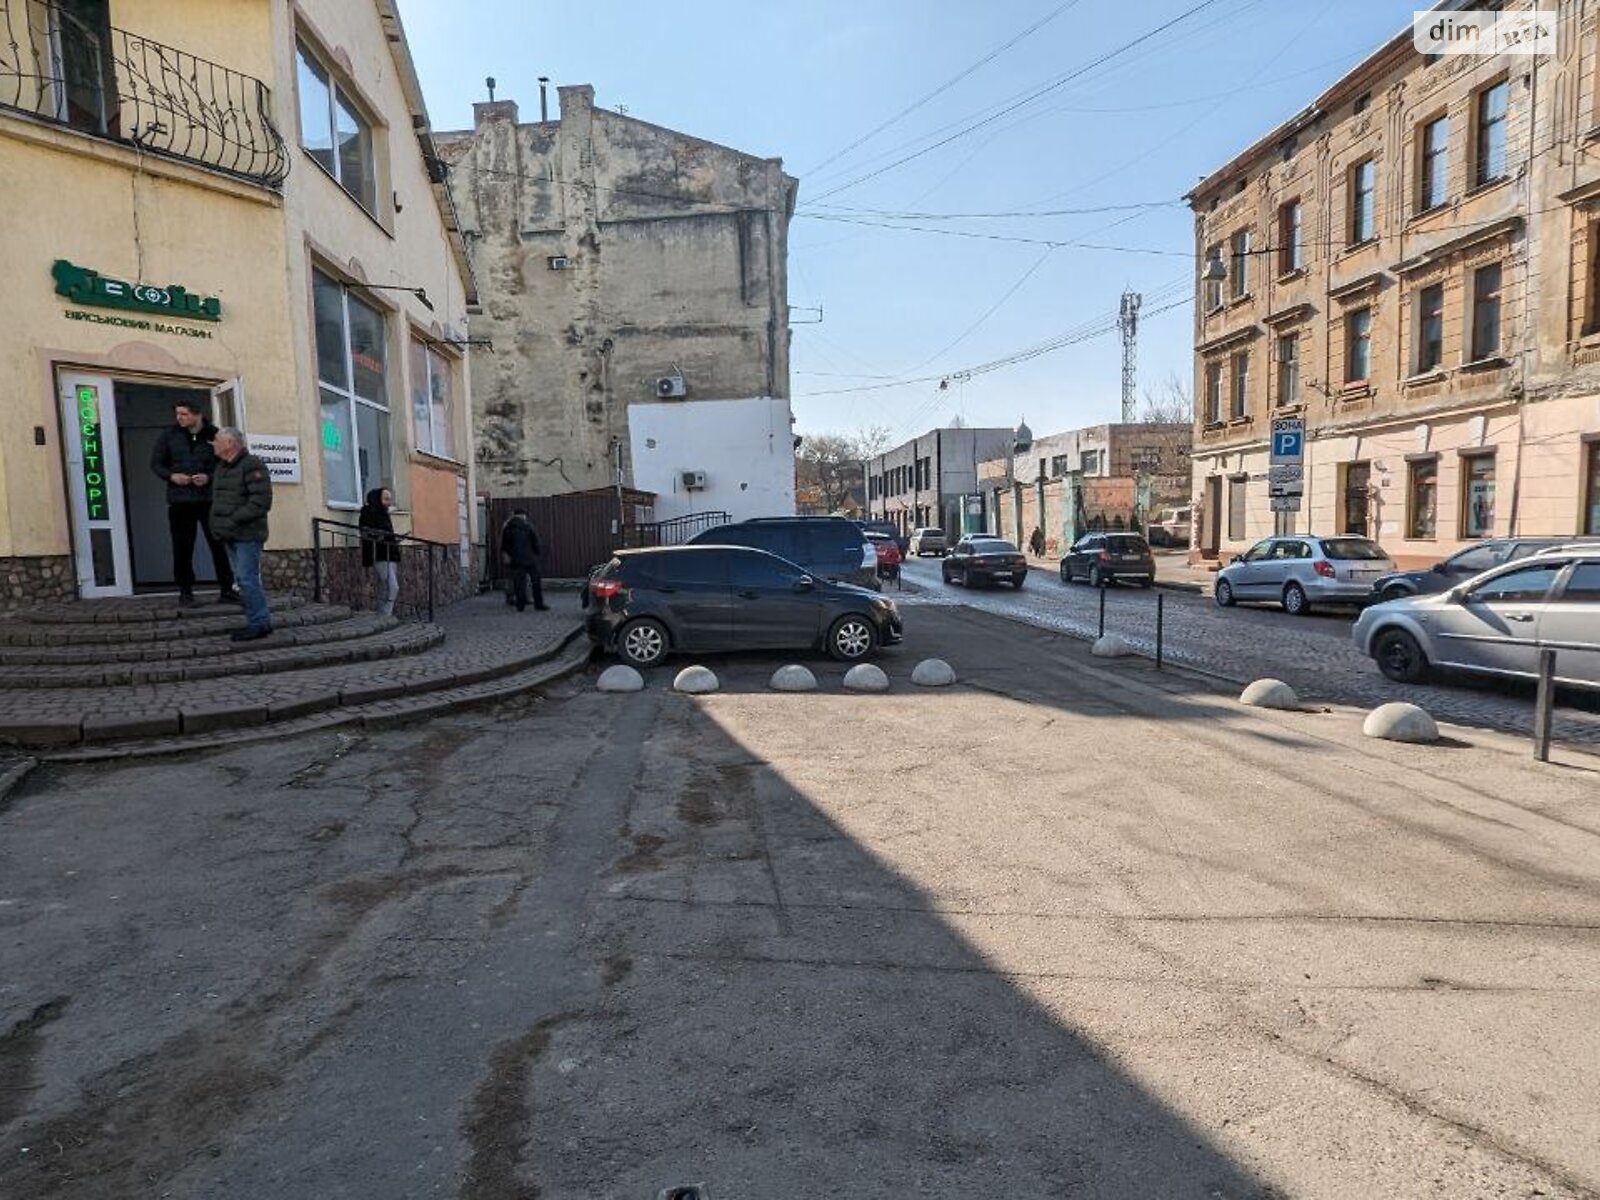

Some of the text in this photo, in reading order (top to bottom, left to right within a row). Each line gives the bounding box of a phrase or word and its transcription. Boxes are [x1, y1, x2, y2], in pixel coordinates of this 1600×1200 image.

[64, 309, 214, 340] ВІЙСЬКОВИЙ МАГАЗИН
[1274, 421, 1303, 431] ЗОНА
